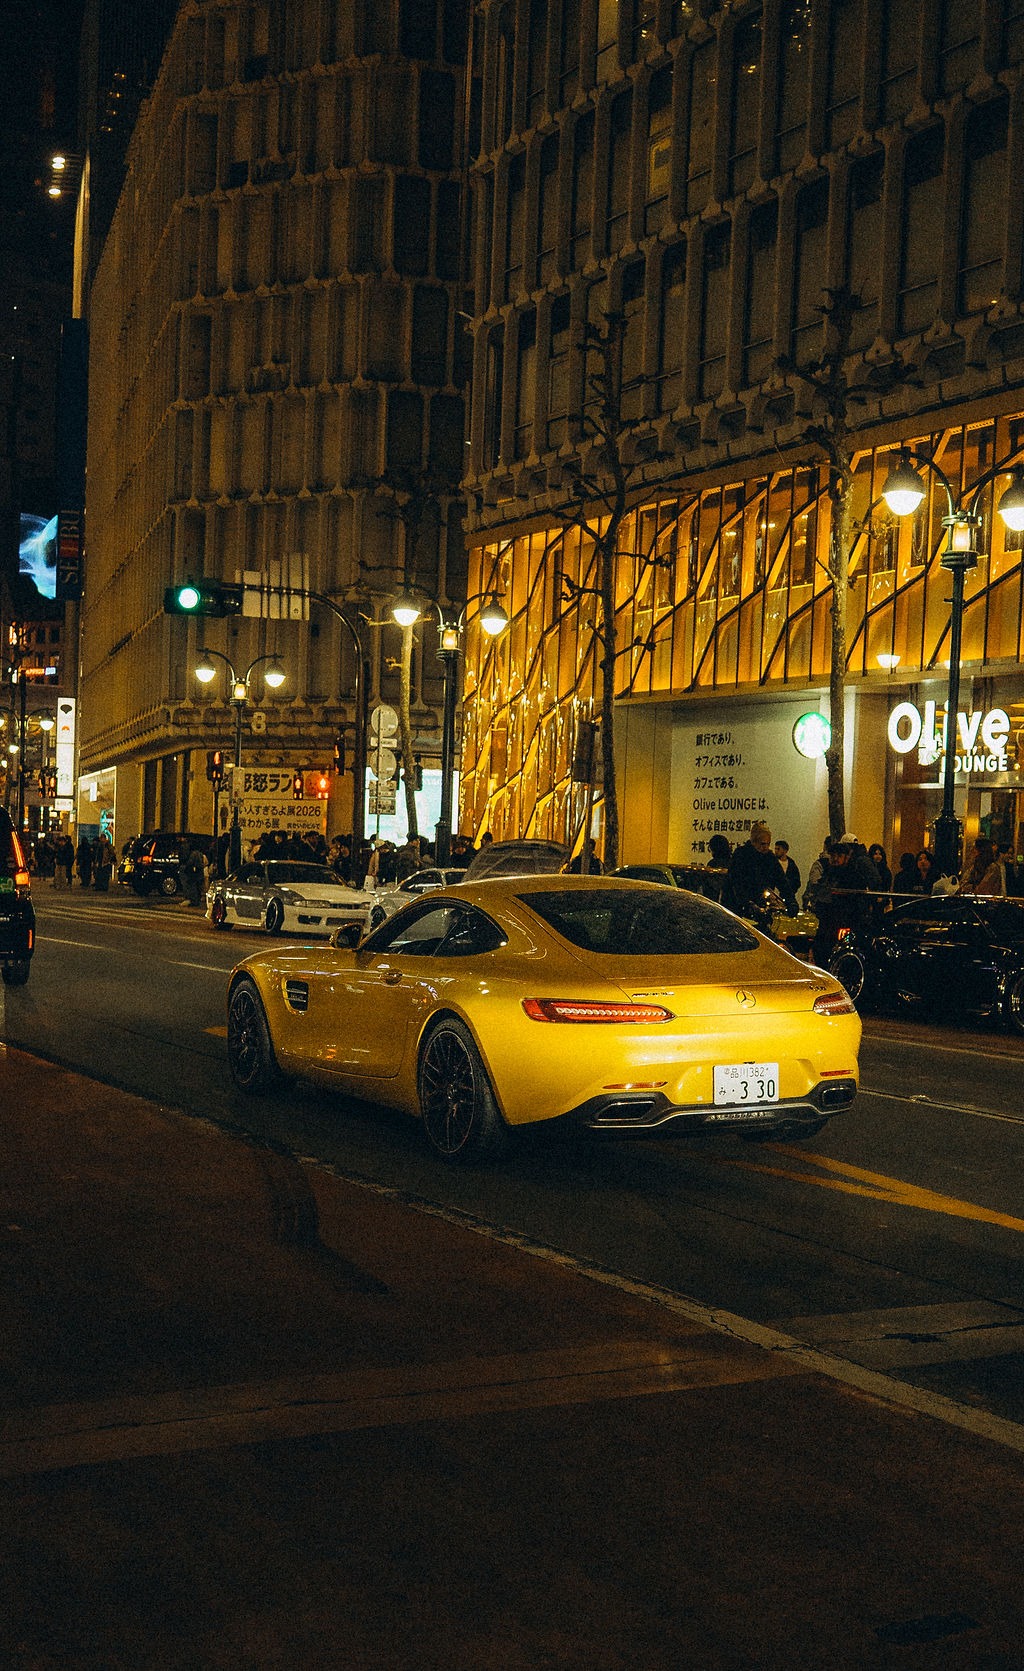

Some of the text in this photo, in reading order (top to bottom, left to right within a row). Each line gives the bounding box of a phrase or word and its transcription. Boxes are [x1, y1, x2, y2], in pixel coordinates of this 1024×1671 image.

[60, 510, 79, 584] SEIBU
[252, 711, 266, 735] 8
[887, 700, 1011, 754] Olive
[695, 754, 745, 767] オフィスであり、
[694, 777, 738, 788] カフェである。
[693, 799, 716, 810] Olive
[718, 798, 757, 810] LOUNGE
